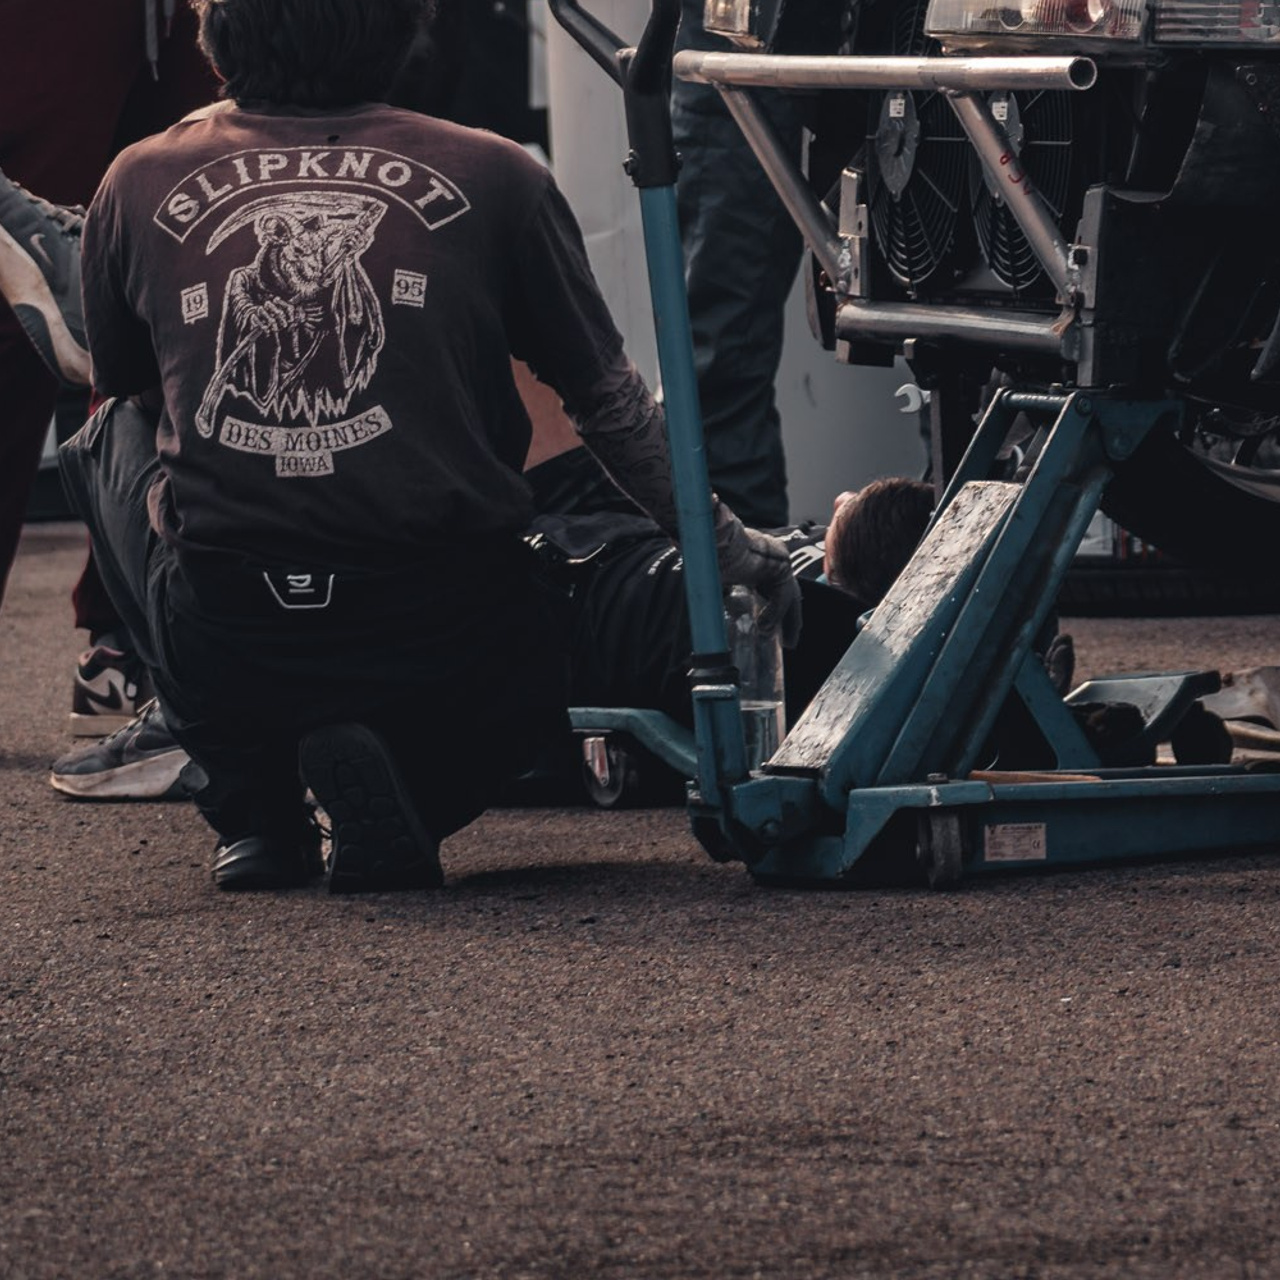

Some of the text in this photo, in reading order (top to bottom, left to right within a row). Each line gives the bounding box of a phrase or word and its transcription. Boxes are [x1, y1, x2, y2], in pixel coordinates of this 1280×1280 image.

[168, 151, 455, 223] SLIPKNOT
[396, 278, 424, 298] 95
[185, 293, 204, 314] 19
[225, 412, 383, 452] DES MOINES
[280, 455, 330, 472] IOWA
